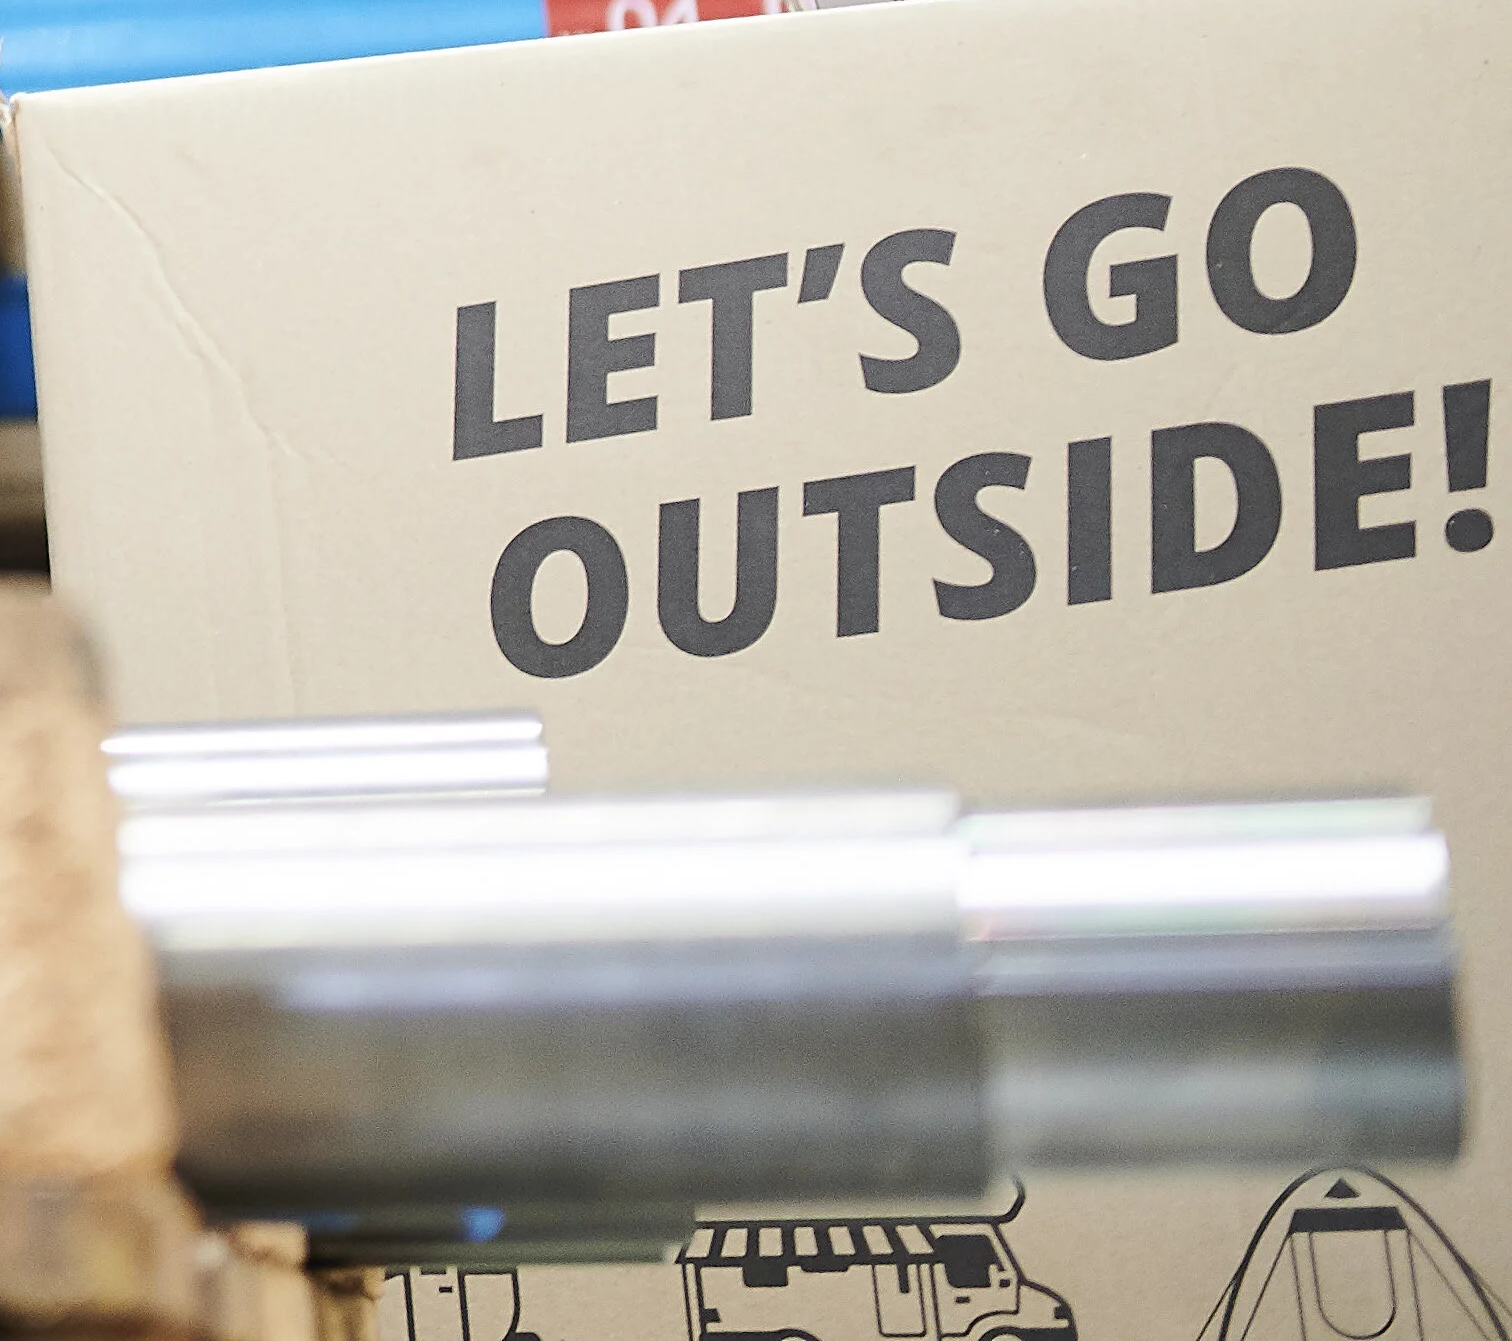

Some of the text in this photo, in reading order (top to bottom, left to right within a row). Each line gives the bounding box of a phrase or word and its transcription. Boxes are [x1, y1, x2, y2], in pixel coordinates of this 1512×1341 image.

[452, 166, 1358, 462] LET'S GO
[489, 378, 1494, 680] OUTSIDE!
